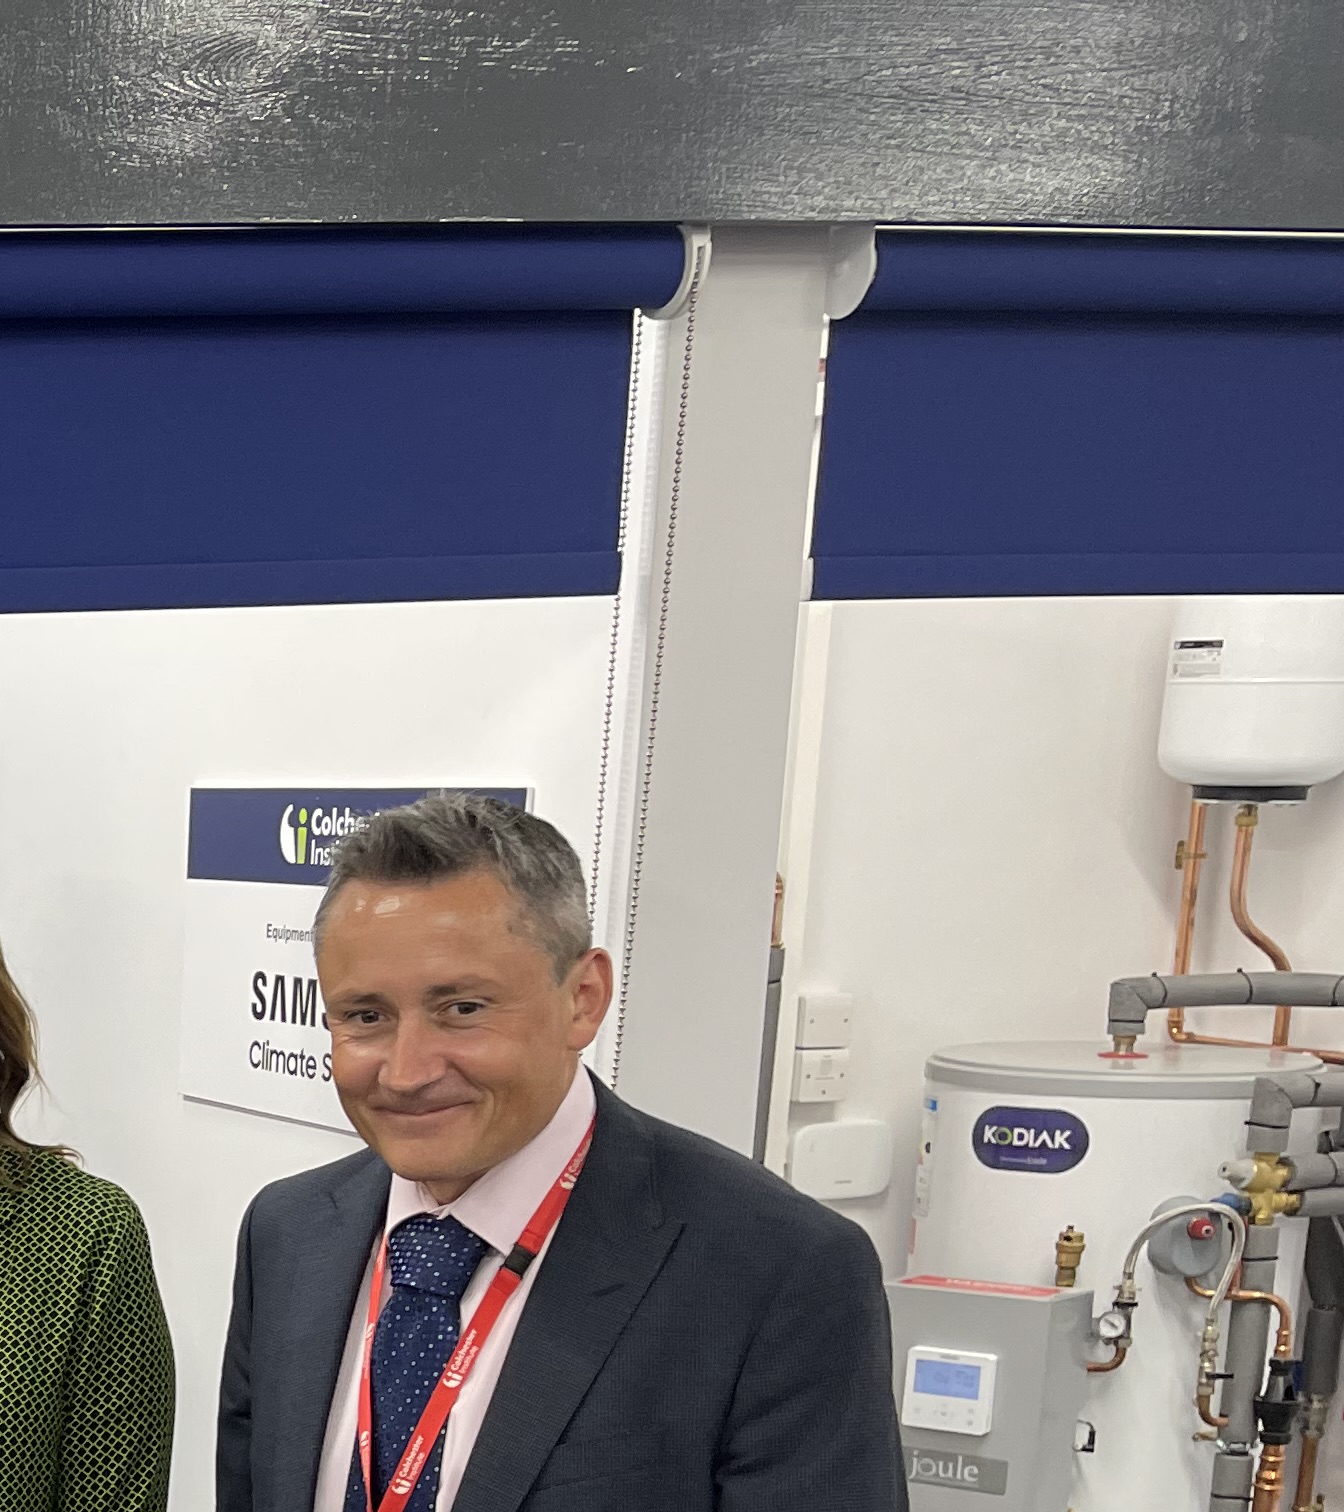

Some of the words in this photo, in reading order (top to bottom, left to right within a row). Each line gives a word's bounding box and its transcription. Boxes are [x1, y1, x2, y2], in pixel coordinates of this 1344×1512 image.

[249, 1039, 317, 1080] Climate
[983, 1124, 1072, 1150] KODIAK
[451, 1328, 477, 1371] Colchester
[398, 1434, 424, 1478] Colchester
[909, 1449, 979, 1482] joule
